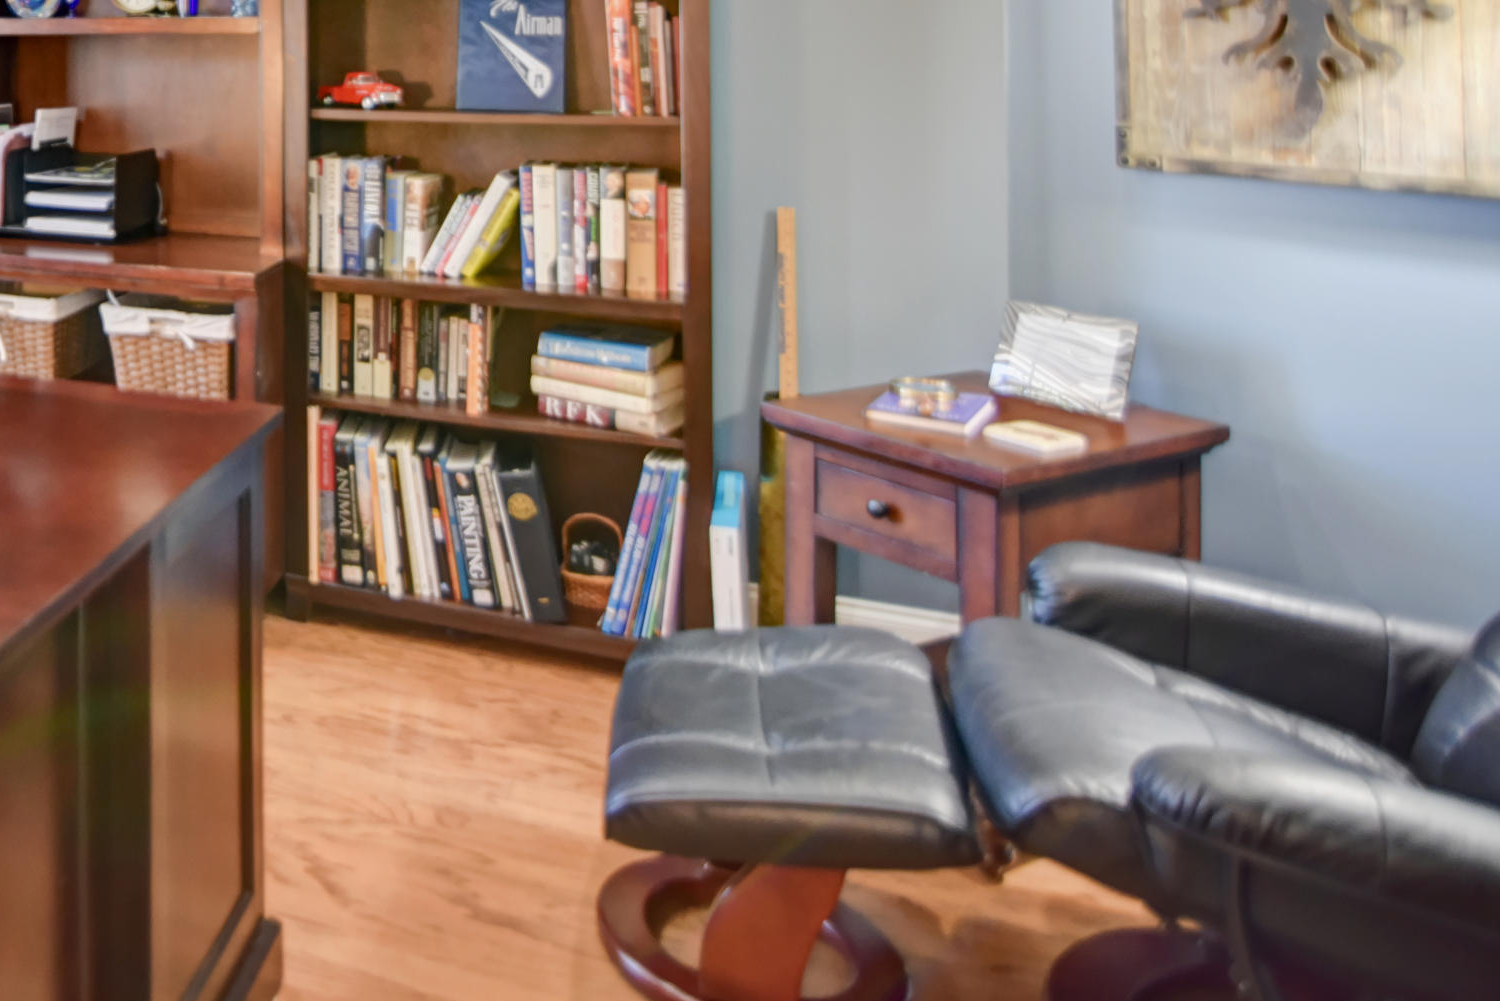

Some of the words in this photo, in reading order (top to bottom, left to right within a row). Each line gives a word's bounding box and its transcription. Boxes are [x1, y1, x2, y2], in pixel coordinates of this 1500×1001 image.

[514, 3, 563, 36] Airman
[544, 395, 605, 427] RFK
[336, 466, 353, 536] ANIMAL
[455, 494, 486, 580] PAINTING
